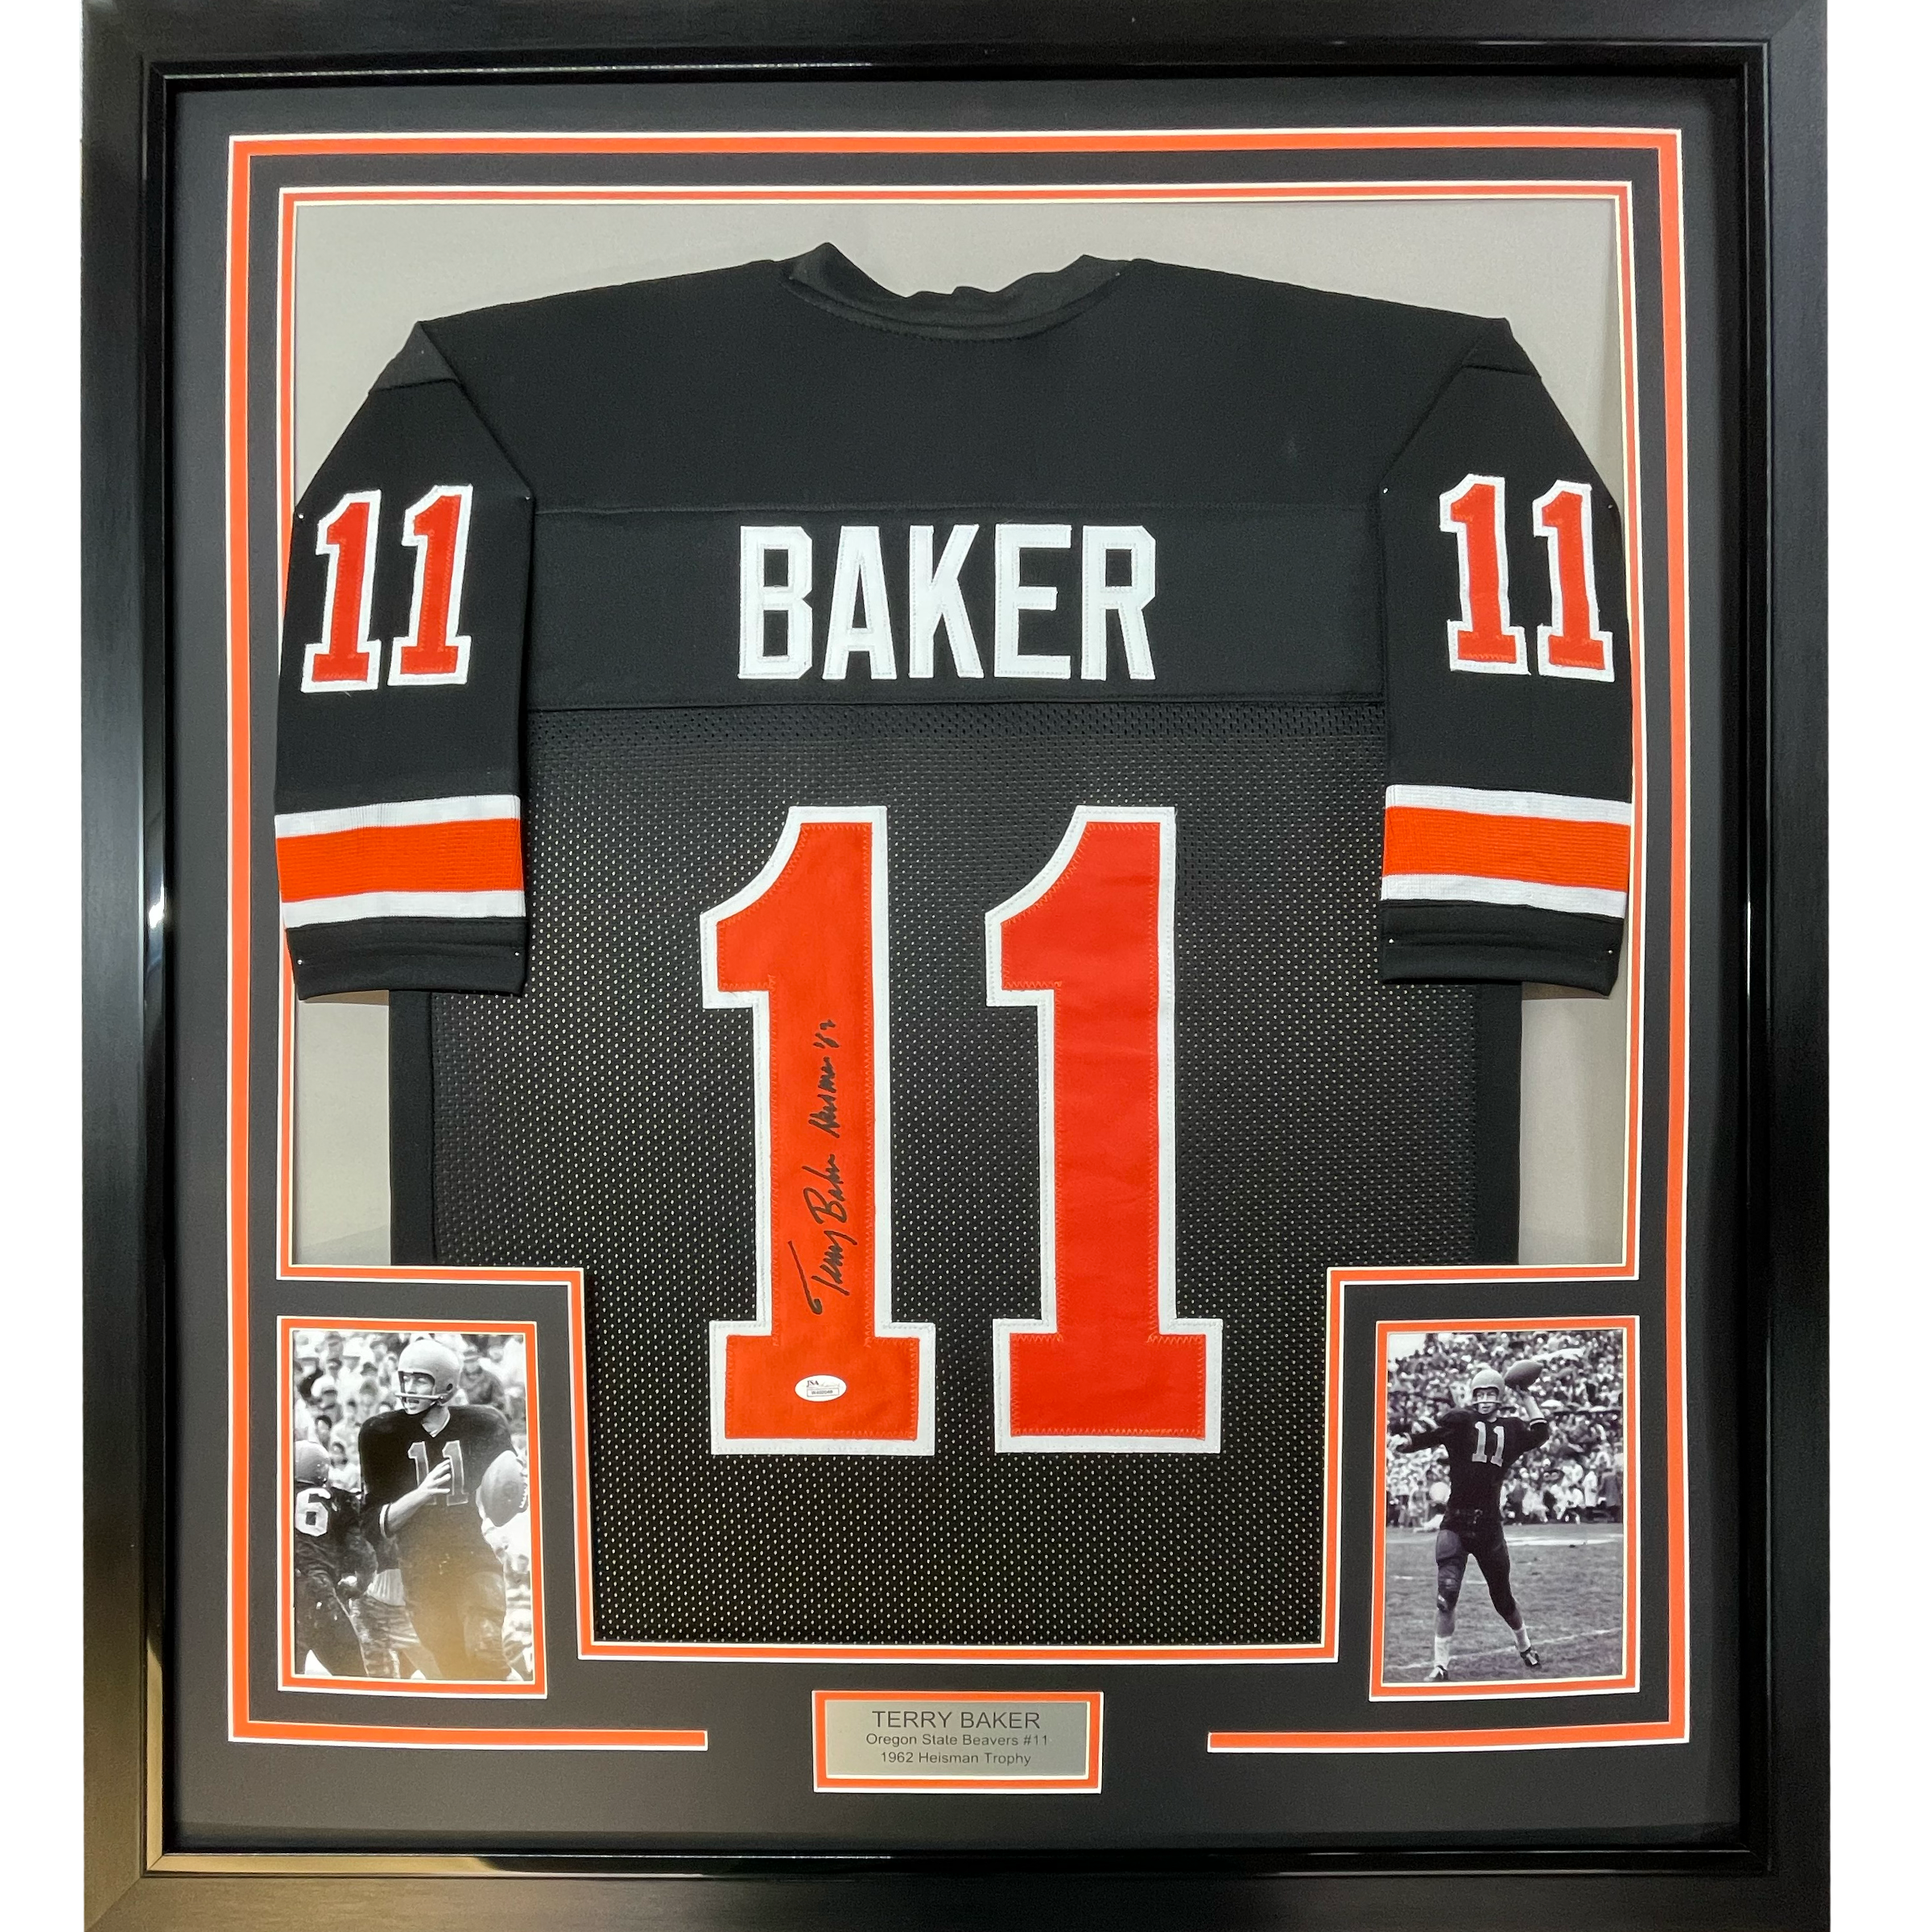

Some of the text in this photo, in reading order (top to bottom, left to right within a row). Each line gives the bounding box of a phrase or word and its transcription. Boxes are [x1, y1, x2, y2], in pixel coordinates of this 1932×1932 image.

[300, 484, 473, 694] 11
[738, 524, 1158, 682] BAKER
[1439, 473, 1615, 683] 11
[699, 805, 1223, 1457] 11
[407, 1439, 469, 1507] 11
[1472, 1421, 1505, 1468] 11
[865, 1733, 1048, 1748] Oregon State Beavers #11
[871, 1711, 1041, 1729] TERRY BAKER
[881, 1752, 1031, 1767] 1962 Heisman Trophy
